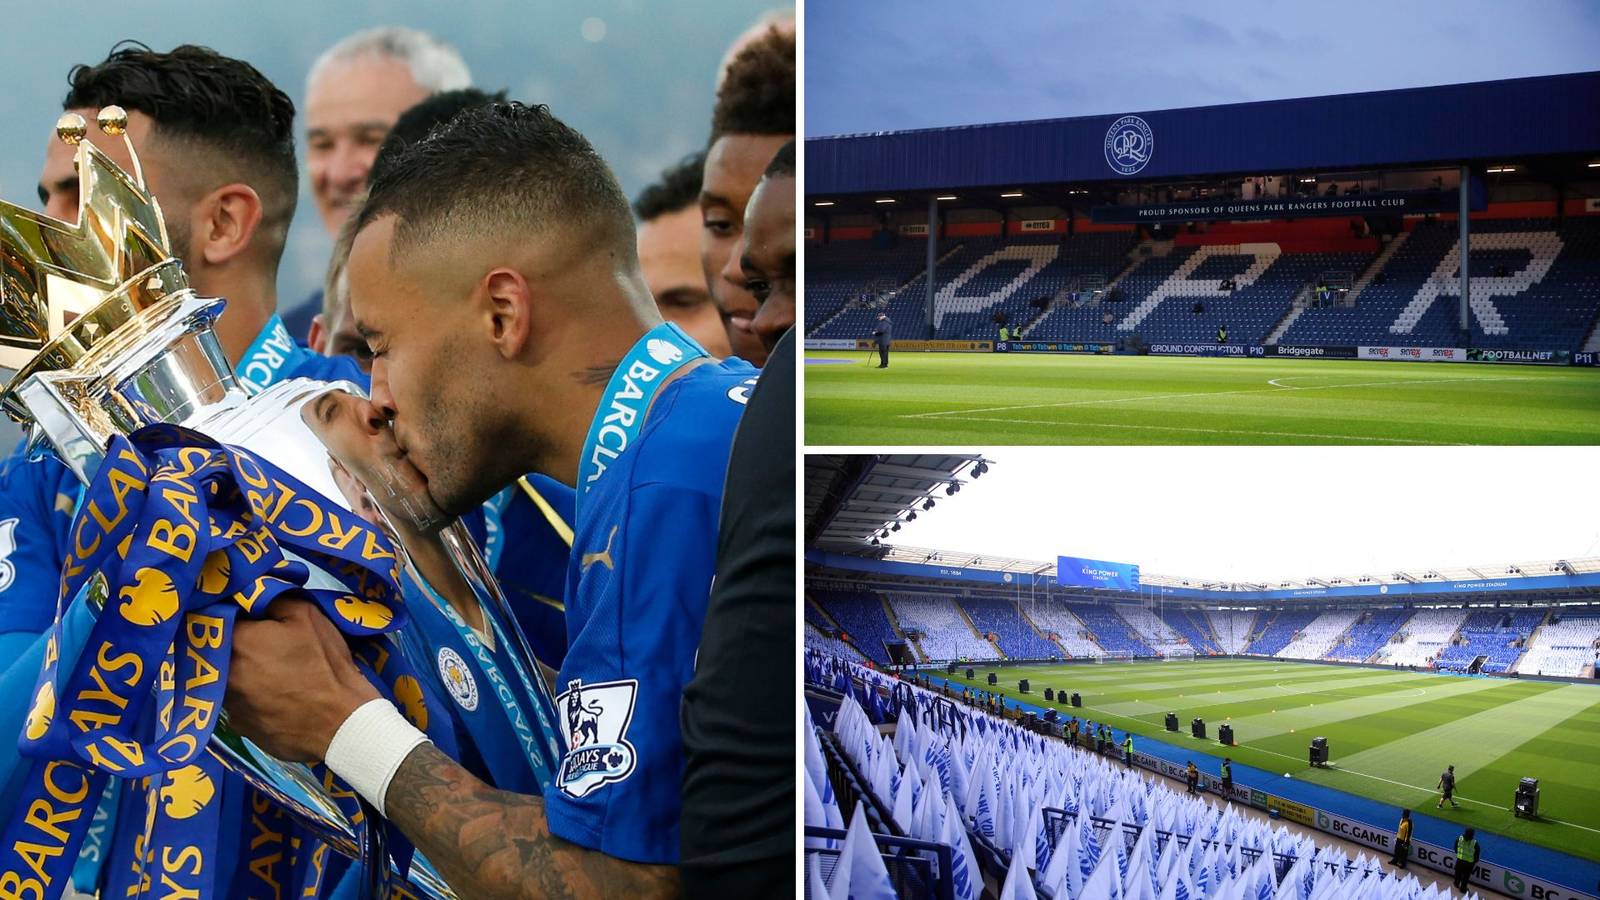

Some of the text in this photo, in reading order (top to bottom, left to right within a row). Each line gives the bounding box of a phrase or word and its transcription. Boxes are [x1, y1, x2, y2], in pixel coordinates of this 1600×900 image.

[1139, 198, 1406, 217] PROUD SPONSORS OF QUEENS PARK RANGERS FOOTBALL CLUB
[1151, 344, 1183, 353] GROUND
[1250, 346, 1264, 355] P10
[1278, 346, 1324, 356] Bridgegate
[1482, 350, 1552, 360] FOOTBALLNET
[1575, 353, 1592, 363] P11
[585, 359, 660, 493] BARCLA
[1333, 819, 1389, 848] BC.GAME
[1417, 847, 1492, 882] BC.GME
